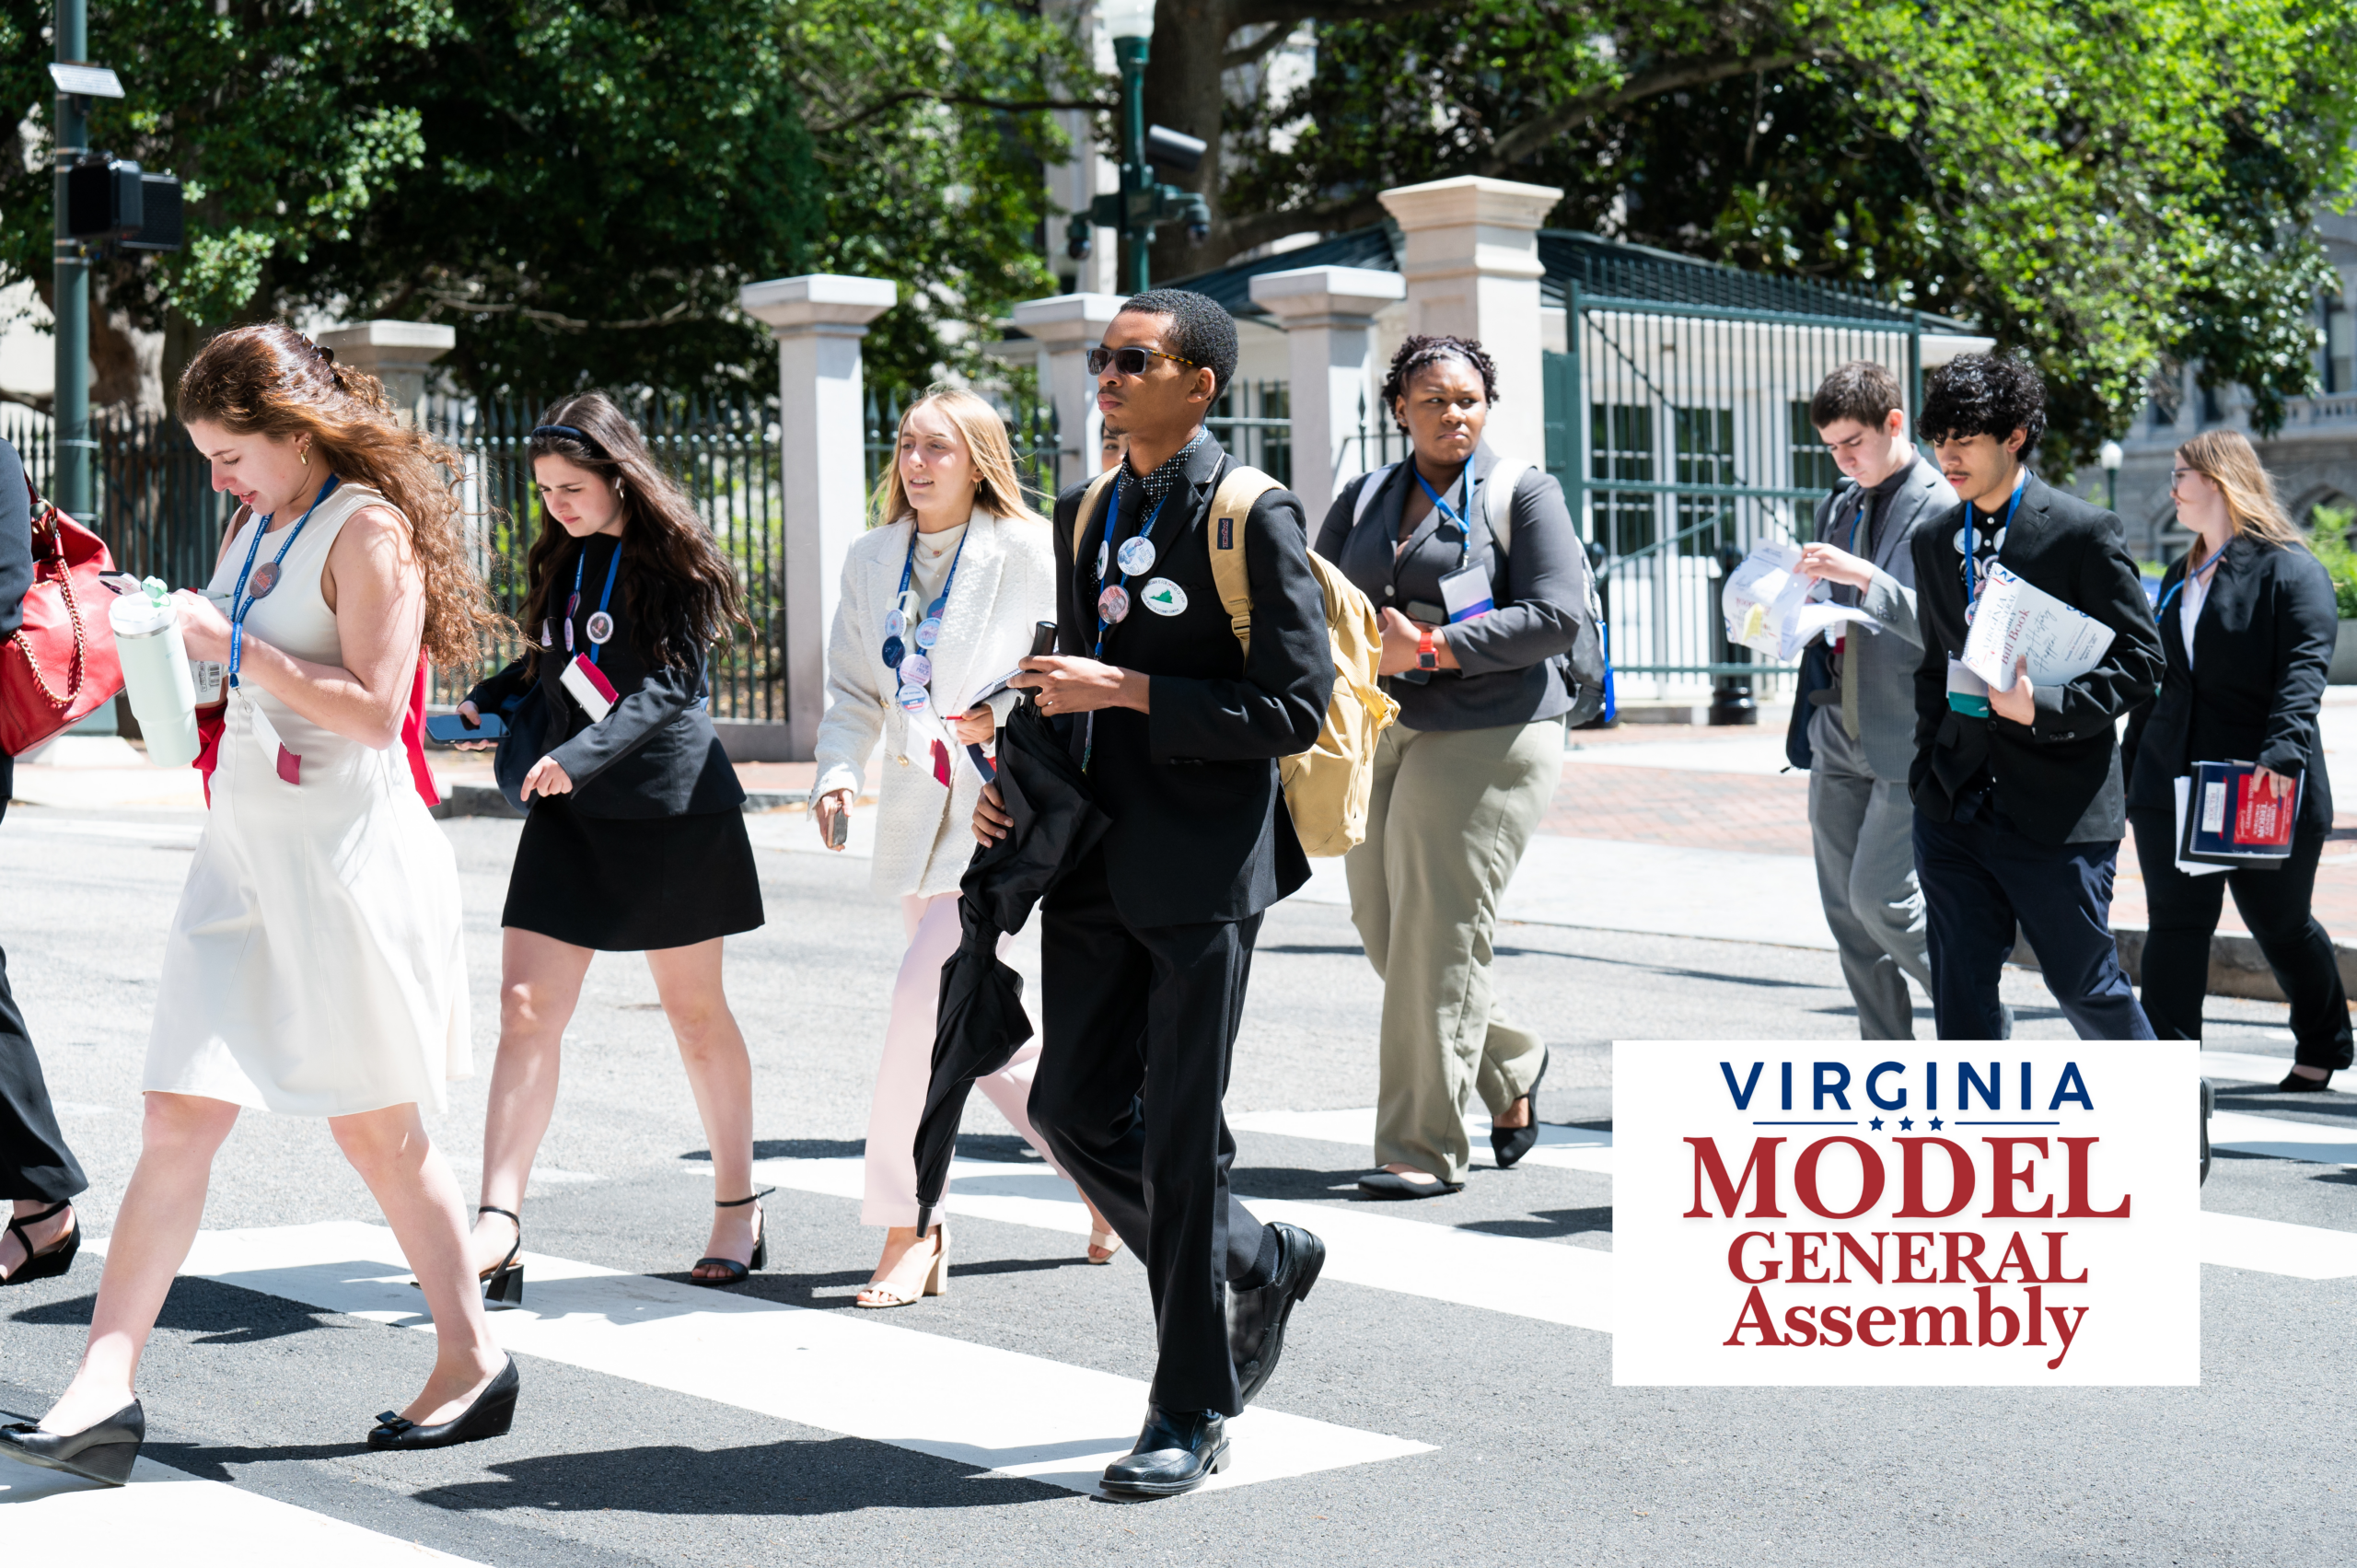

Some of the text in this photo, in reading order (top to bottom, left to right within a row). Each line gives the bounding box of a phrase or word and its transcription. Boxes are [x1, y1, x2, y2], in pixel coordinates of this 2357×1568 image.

[1982, 598, 2007, 648] VIRGINIA
[1997, 594, 2017, 632] GENERAL
[2024, 608, 2057, 646] History
[2001, 609, 2031, 666] Bill Book
[2073, 621, 2089, 645] Government
[2033, 633, 2059, 673] Happen!
[2208, 792, 2216, 821] YOUTH
[2245, 800, 2253, 829] LEADERS
[2258, 801, 2268, 839] MODEL
